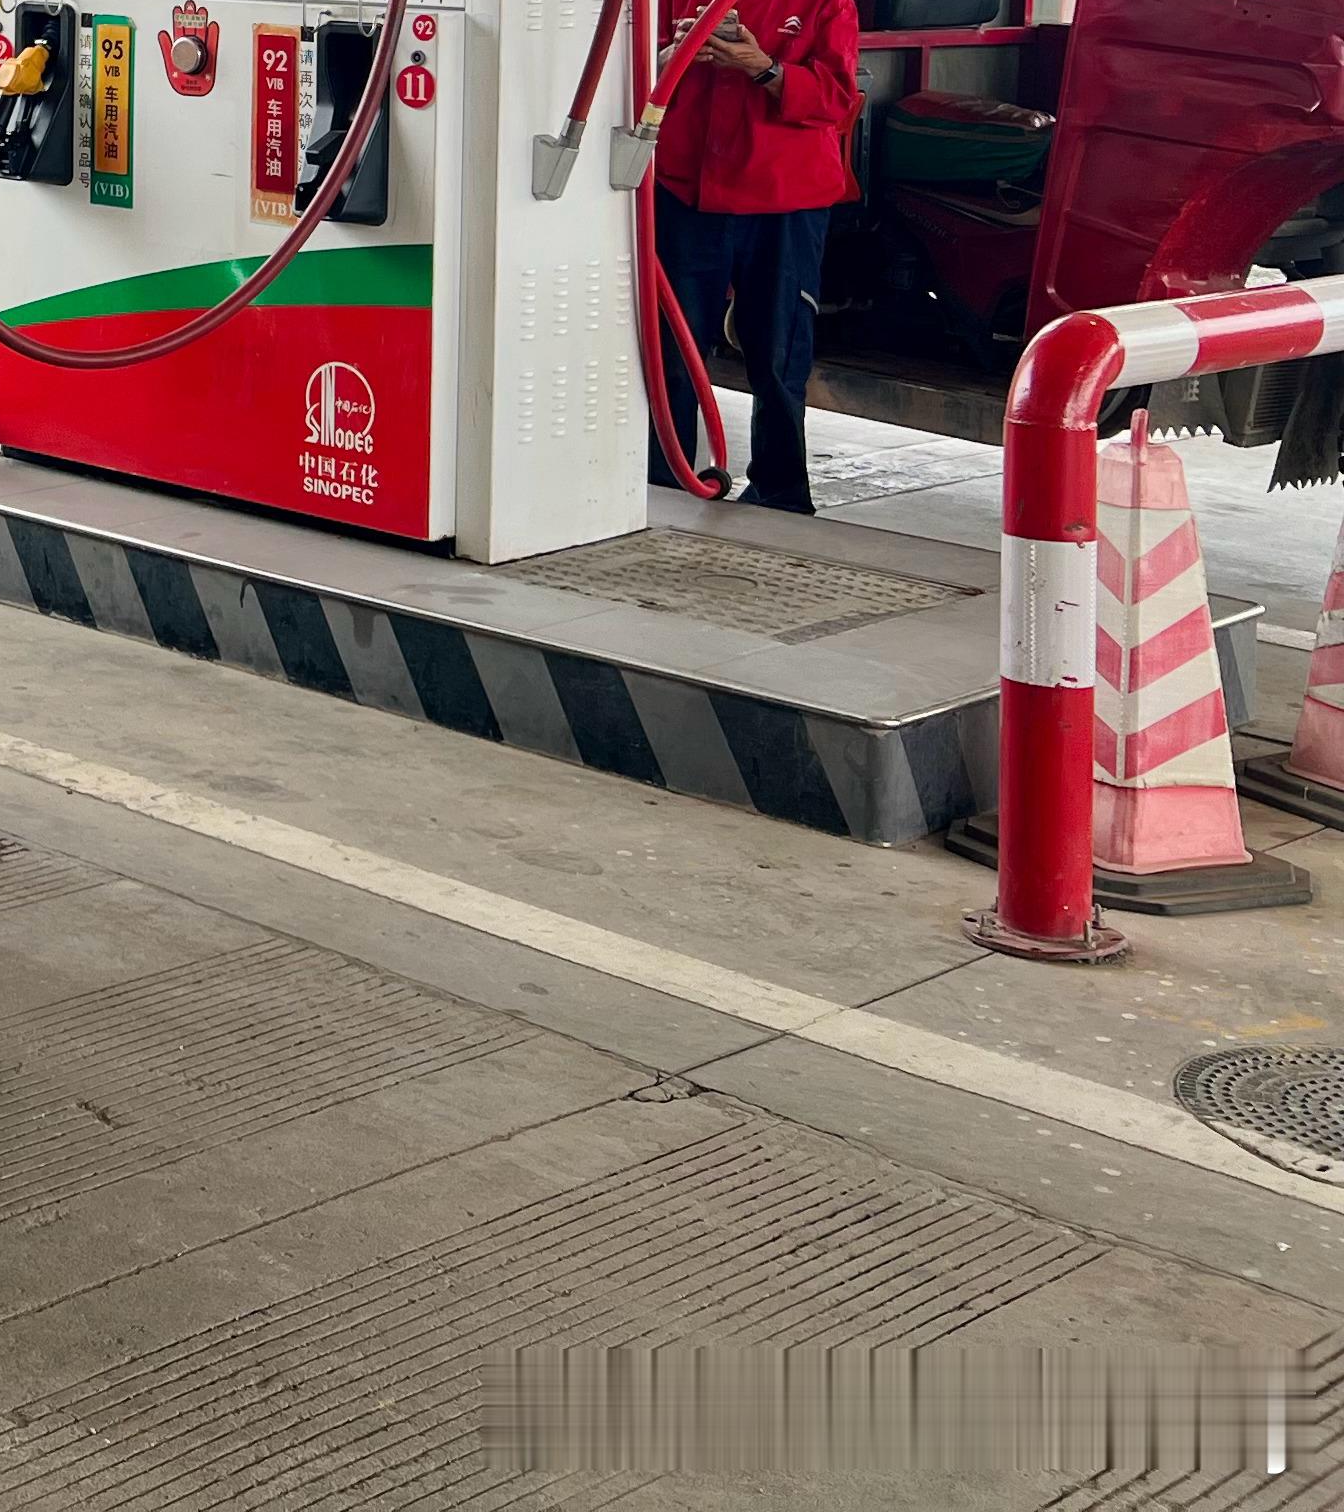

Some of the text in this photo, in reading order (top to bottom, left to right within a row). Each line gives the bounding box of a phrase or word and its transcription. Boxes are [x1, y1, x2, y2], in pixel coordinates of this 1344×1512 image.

[416, 20, 434, 35] 92
[102, 38, 124, 60] 95
[262, 49, 288, 72] 92
[402, 72, 428, 102] 11
[104, 85, 119, 160] 车用汽油
[265, 98, 283, 178] 车用汽油
[298, 451, 380, 488] 中国石化
[303, 476, 375, 506] SINOPEC
